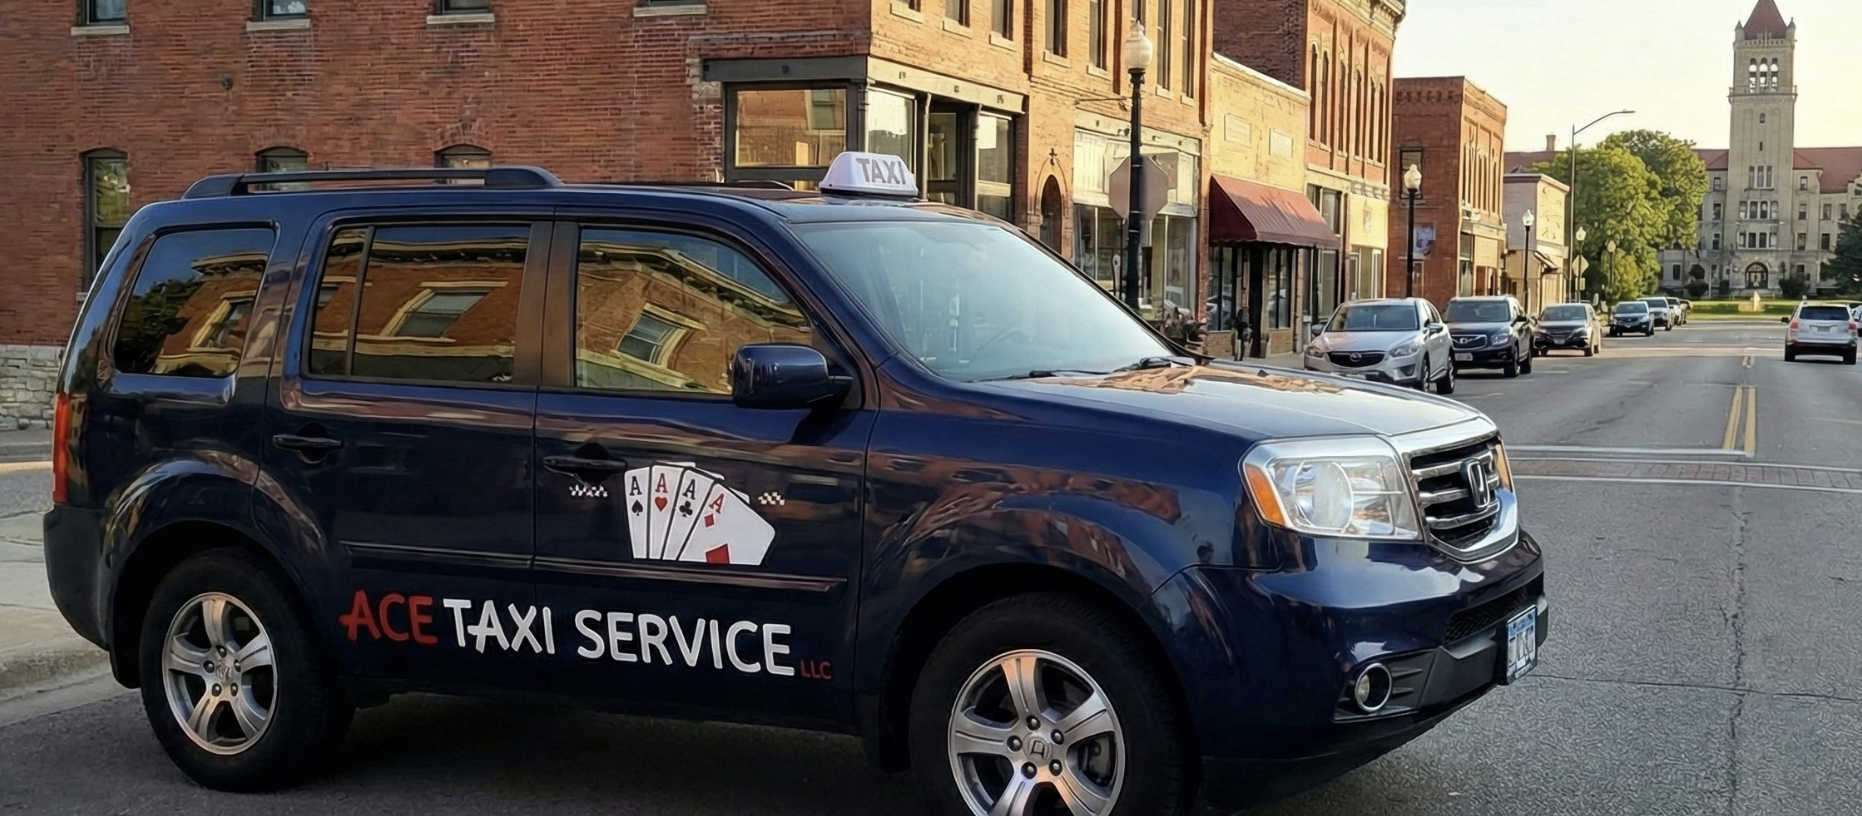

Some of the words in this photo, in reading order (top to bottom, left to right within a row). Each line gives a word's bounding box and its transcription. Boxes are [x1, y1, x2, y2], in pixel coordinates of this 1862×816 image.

[856, 158, 906, 185] TAXI
[629, 476, 643, 496] A
[655, 473, 668, 493] A
[683, 479, 696, 500] A
[709, 493, 725, 514] A
[339, 590, 437, 644] ACE
[443, 597, 556, 654] TAXI
[575, 608, 796, 676] SERVICE
[800, 659, 832, 680] LLC
